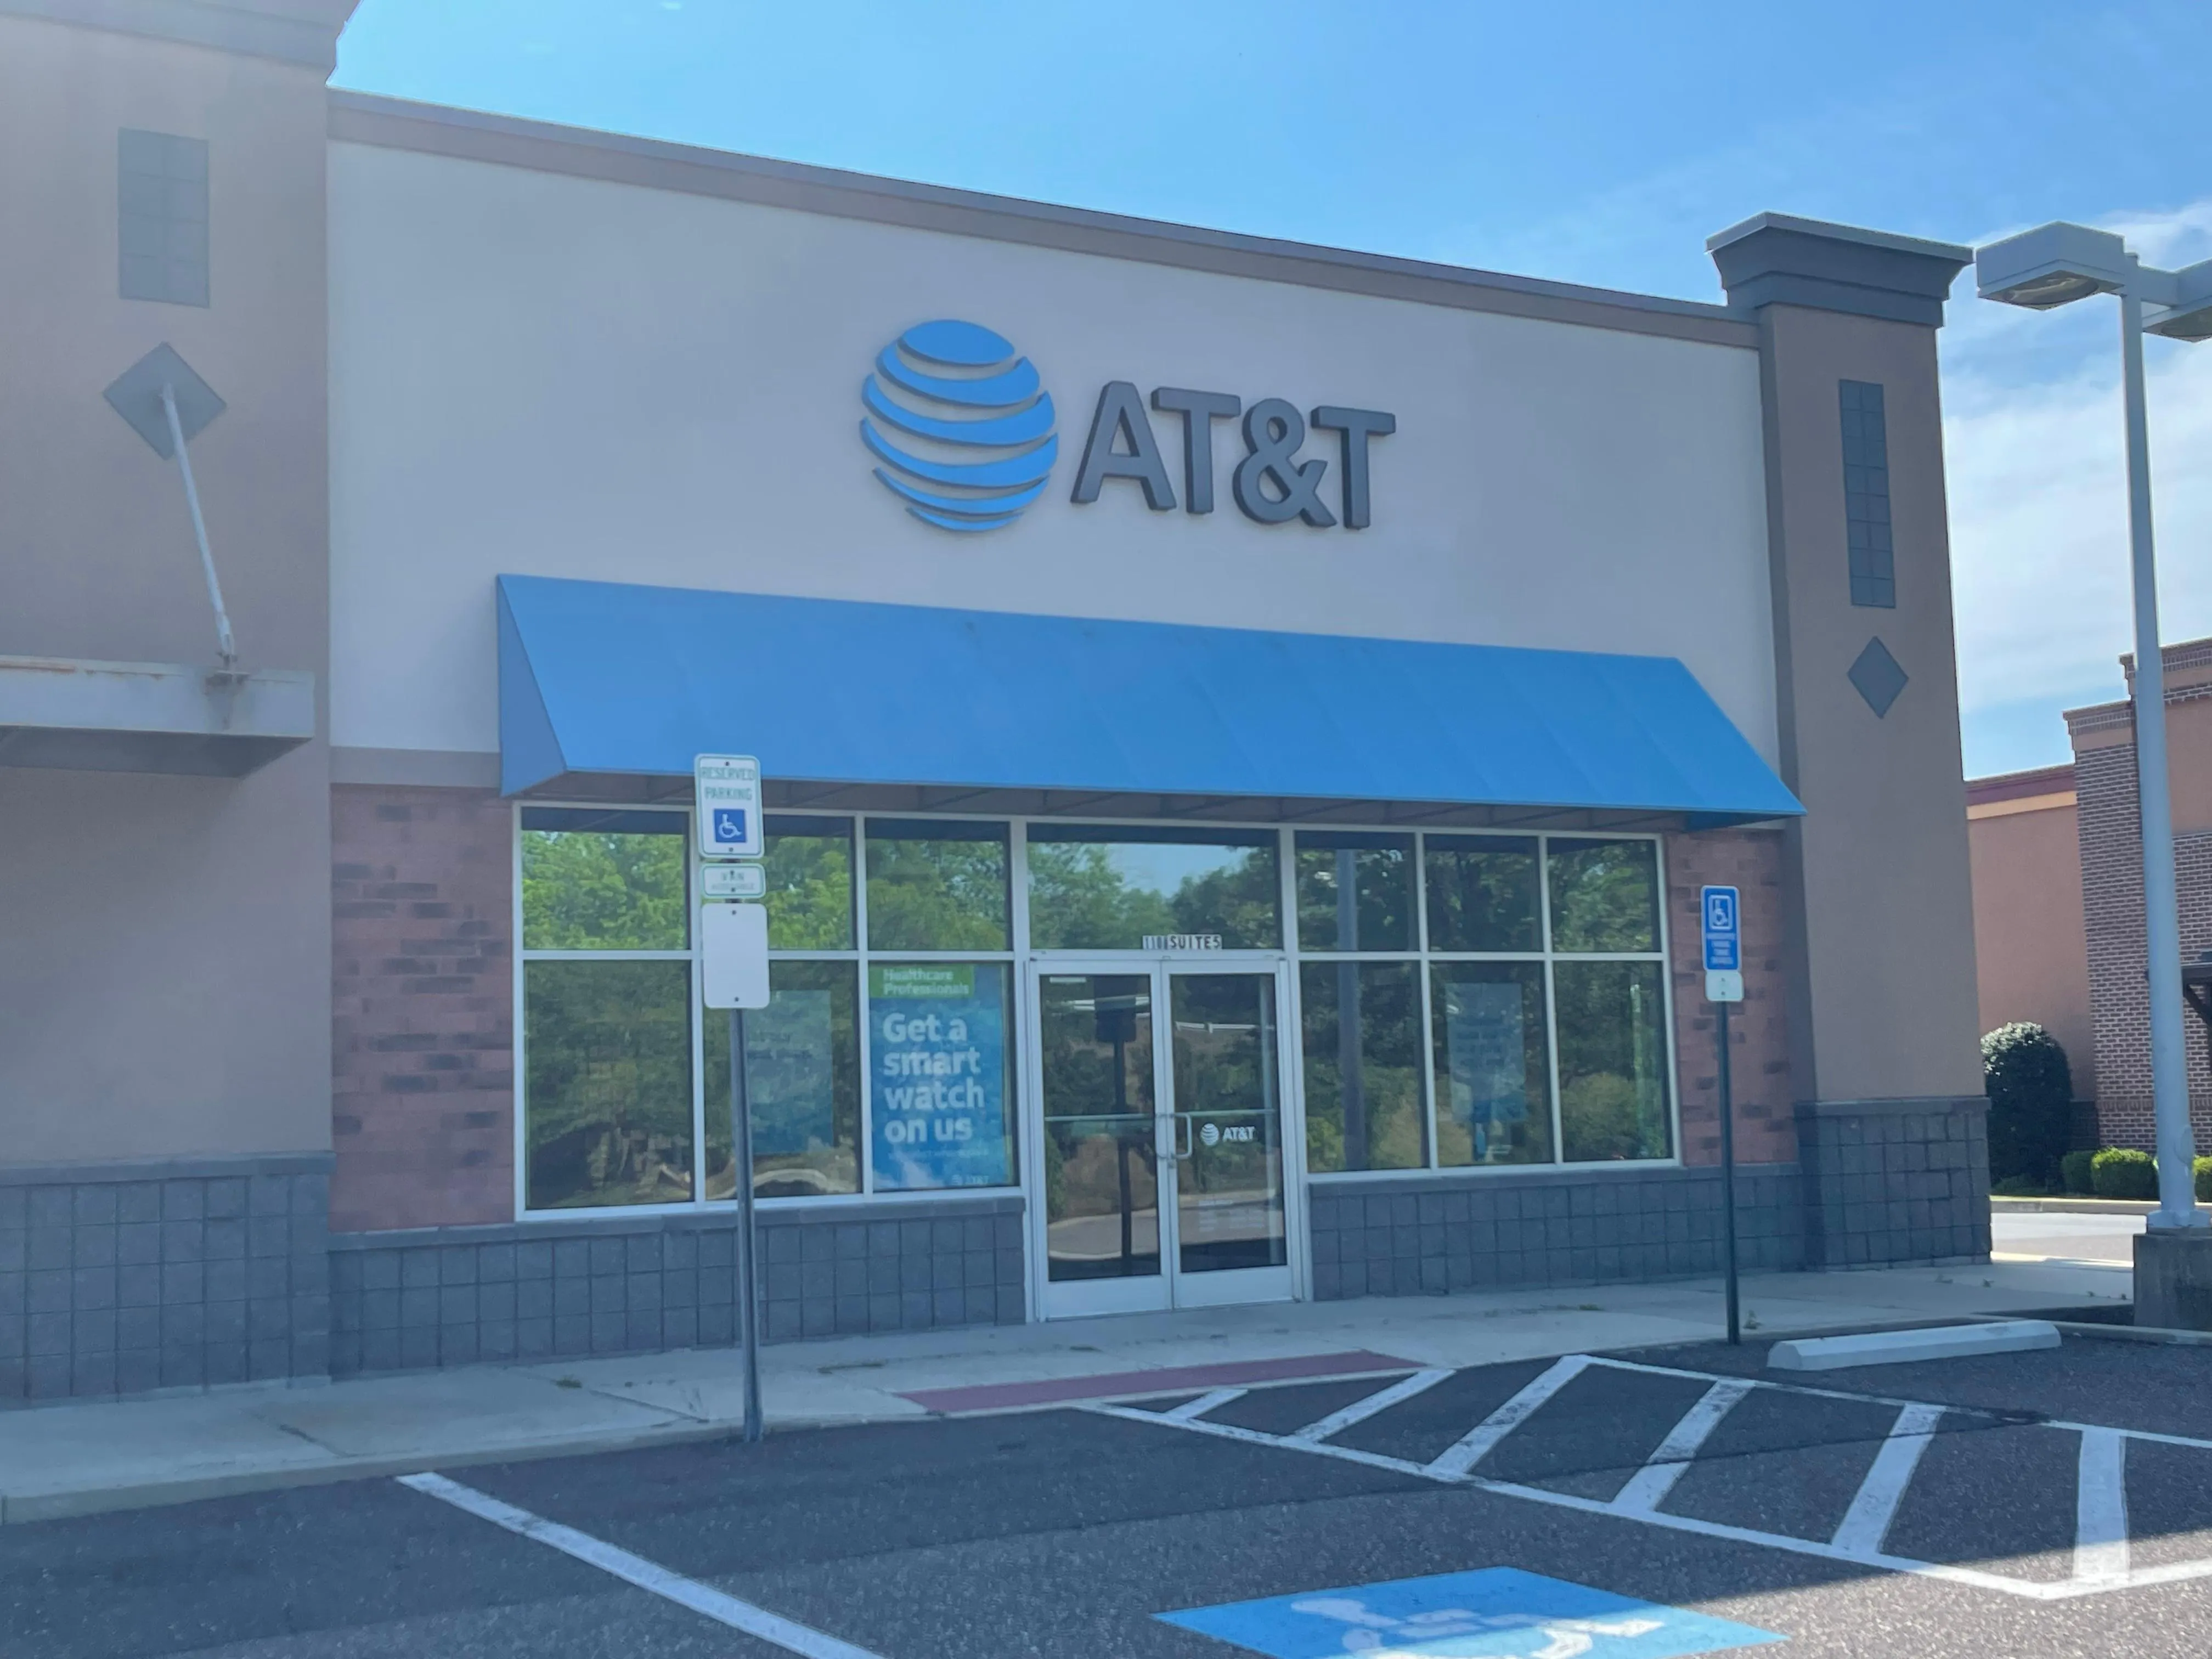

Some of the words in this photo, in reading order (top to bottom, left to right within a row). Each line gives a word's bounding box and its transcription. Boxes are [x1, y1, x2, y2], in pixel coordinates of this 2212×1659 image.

[1070, 380, 1396, 529] AT&T
[704, 787, 752, 800] PARKING
[883, 968, 953, 980] Healthcare
[883, 983, 969, 995] Professionals
[883, 1013, 941, 1042] Get
[948, 1017, 967, 1041] a
[883, 1047, 981, 1076] smart
[884, 1077, 985, 1110] watch
[884, 1118, 927, 1143] on
[935, 1117, 972, 1141] us
[1222, 1126, 1255, 1142] AT&T
